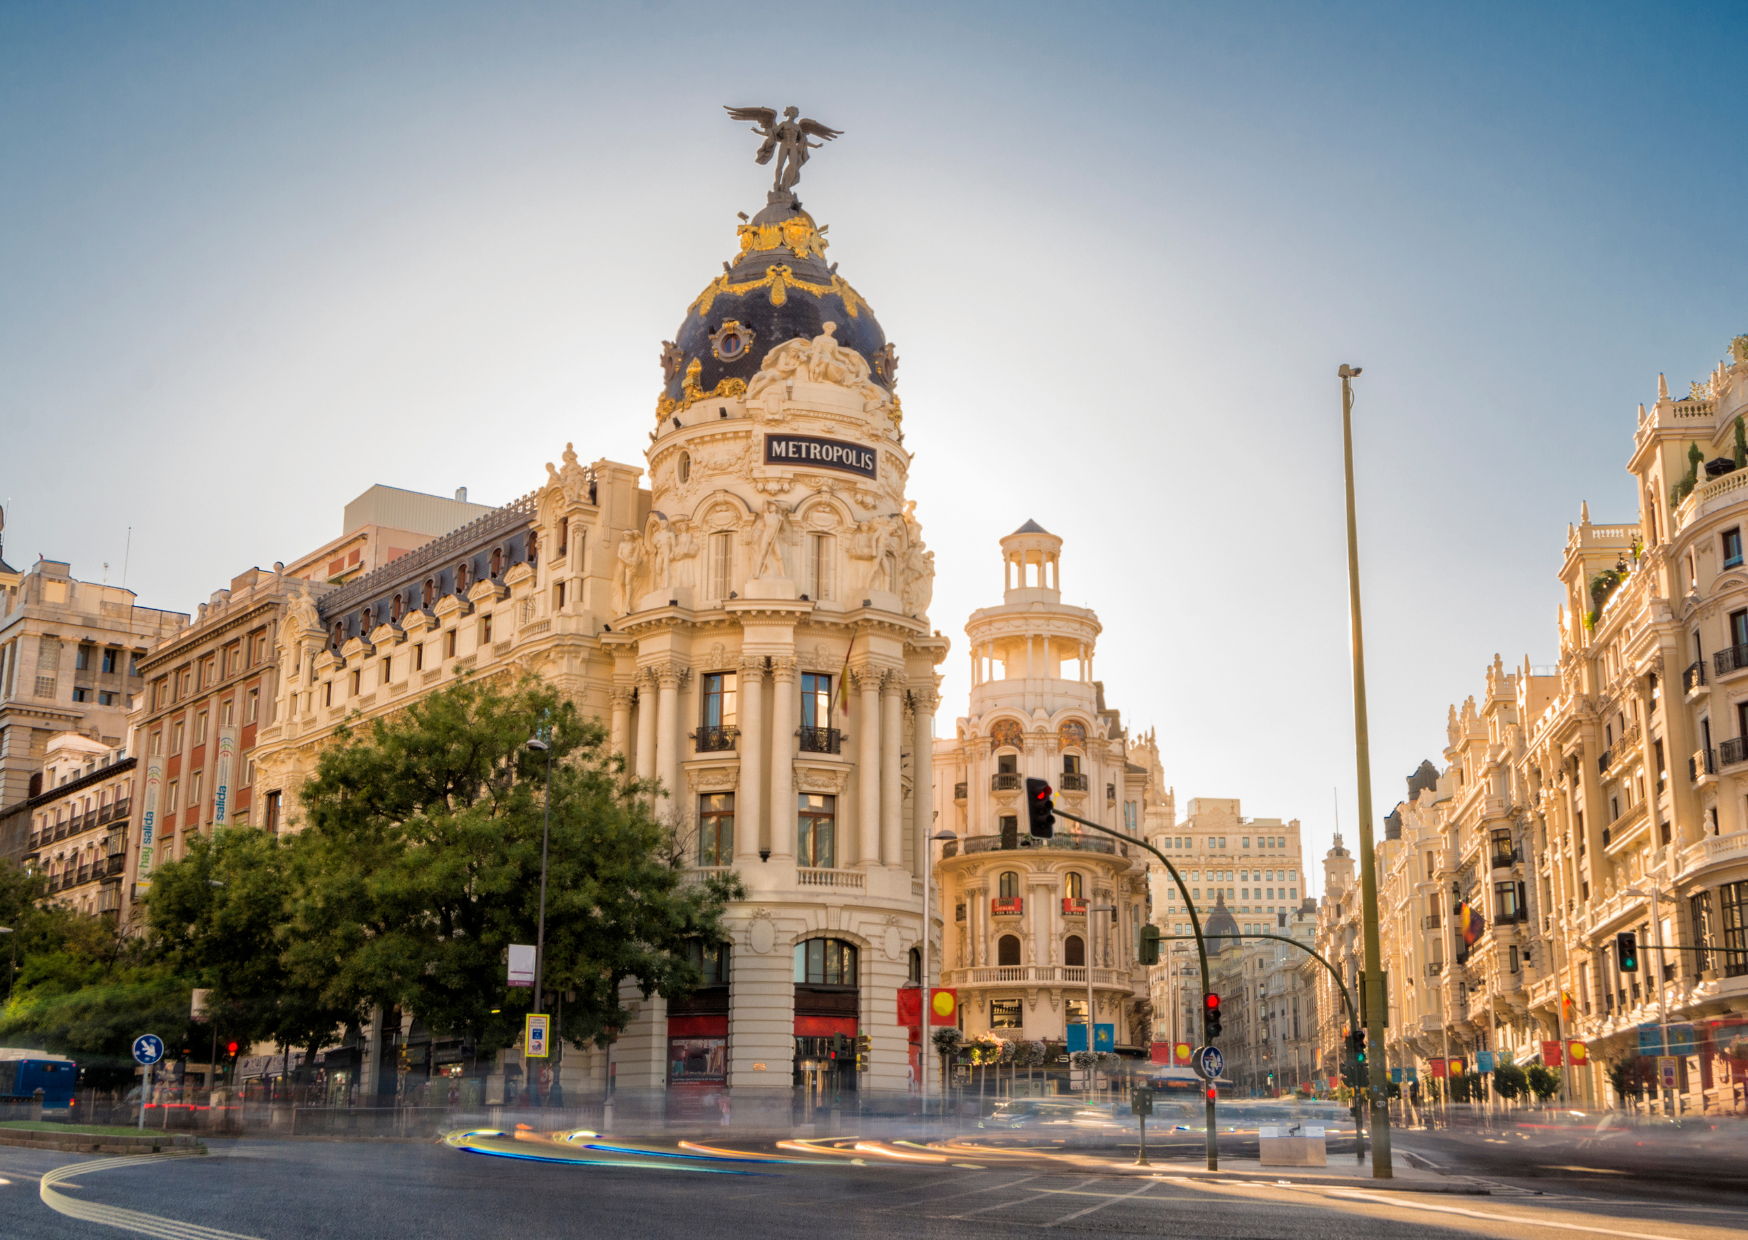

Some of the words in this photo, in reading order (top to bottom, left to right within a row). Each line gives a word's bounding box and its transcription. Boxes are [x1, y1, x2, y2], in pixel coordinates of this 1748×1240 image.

[772, 441, 873, 470] METROPOLIS
[215, 785, 227, 821] salida
[142, 811, 154, 844] salida
[139, 846, 154, 868] hay
